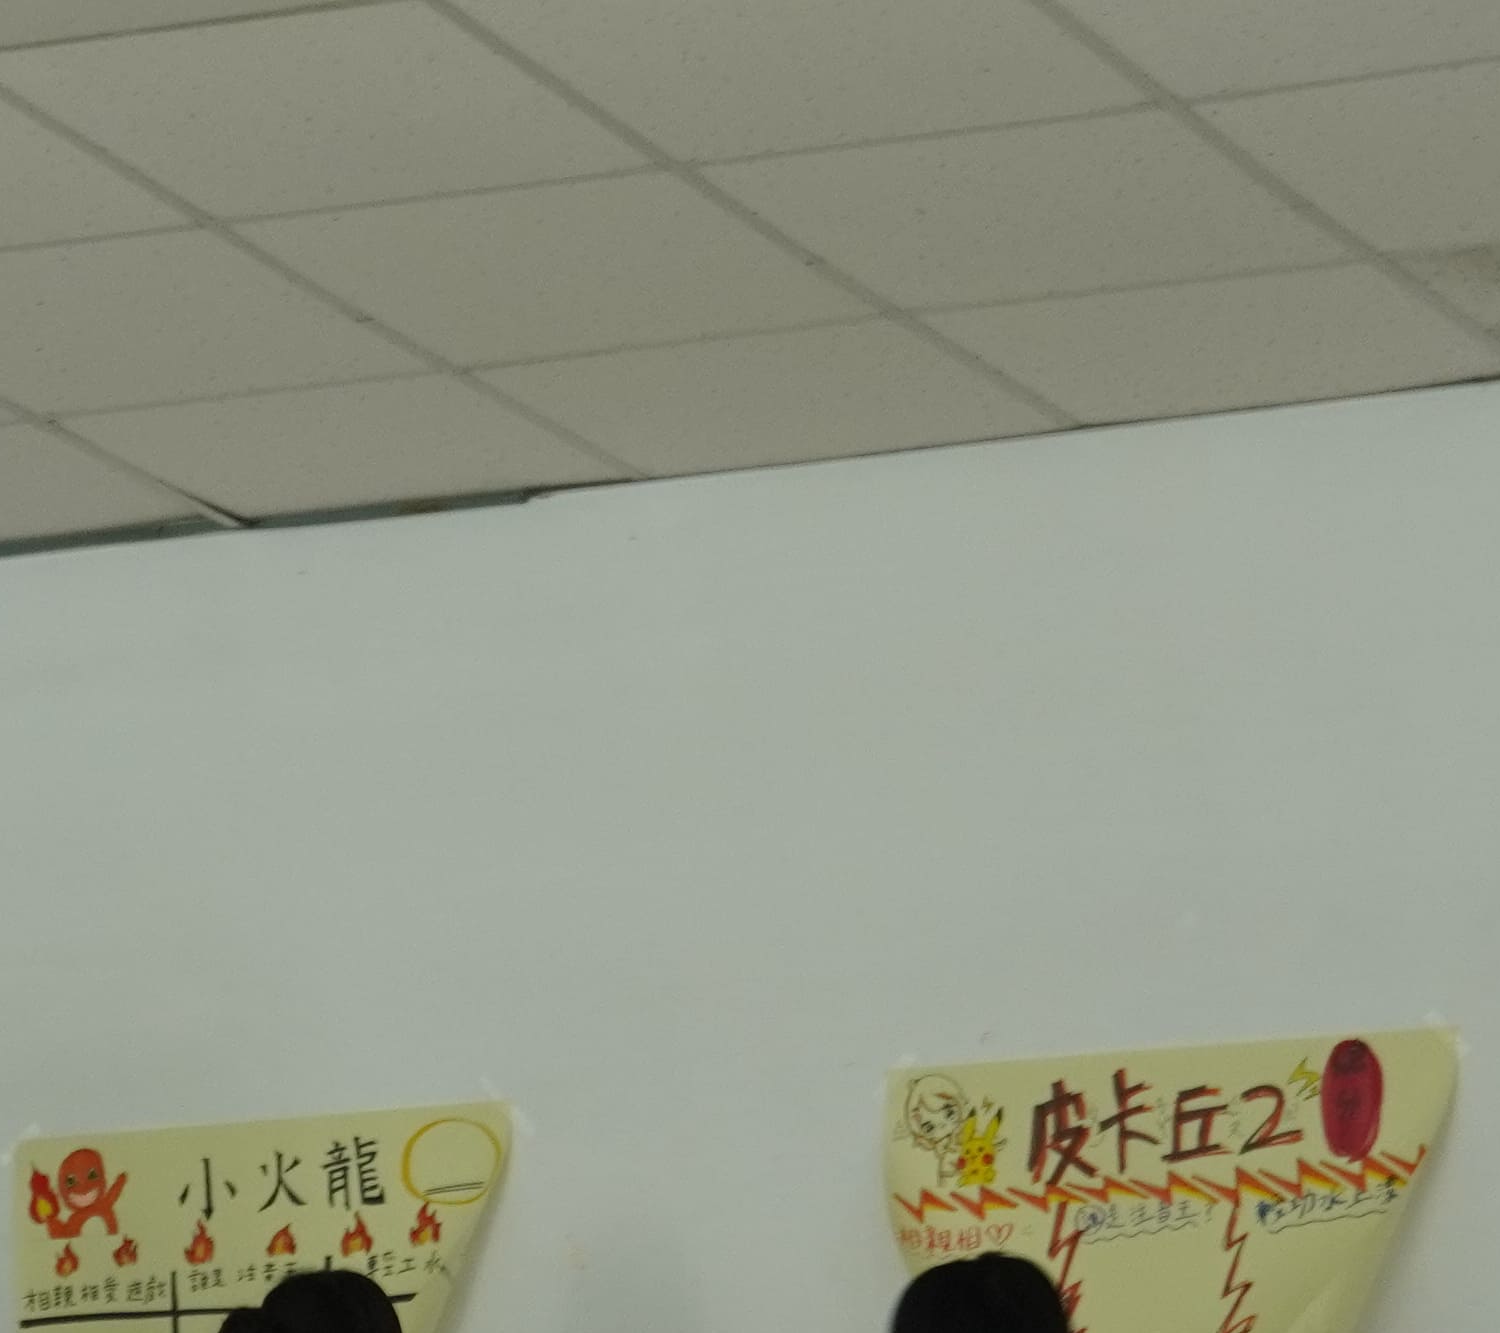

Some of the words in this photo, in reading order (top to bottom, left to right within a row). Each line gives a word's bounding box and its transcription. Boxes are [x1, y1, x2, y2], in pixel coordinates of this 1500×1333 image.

[1028, 1068, 1304, 1185] 皮卡丘2
[179, 1136, 386, 1221] 小火龍
